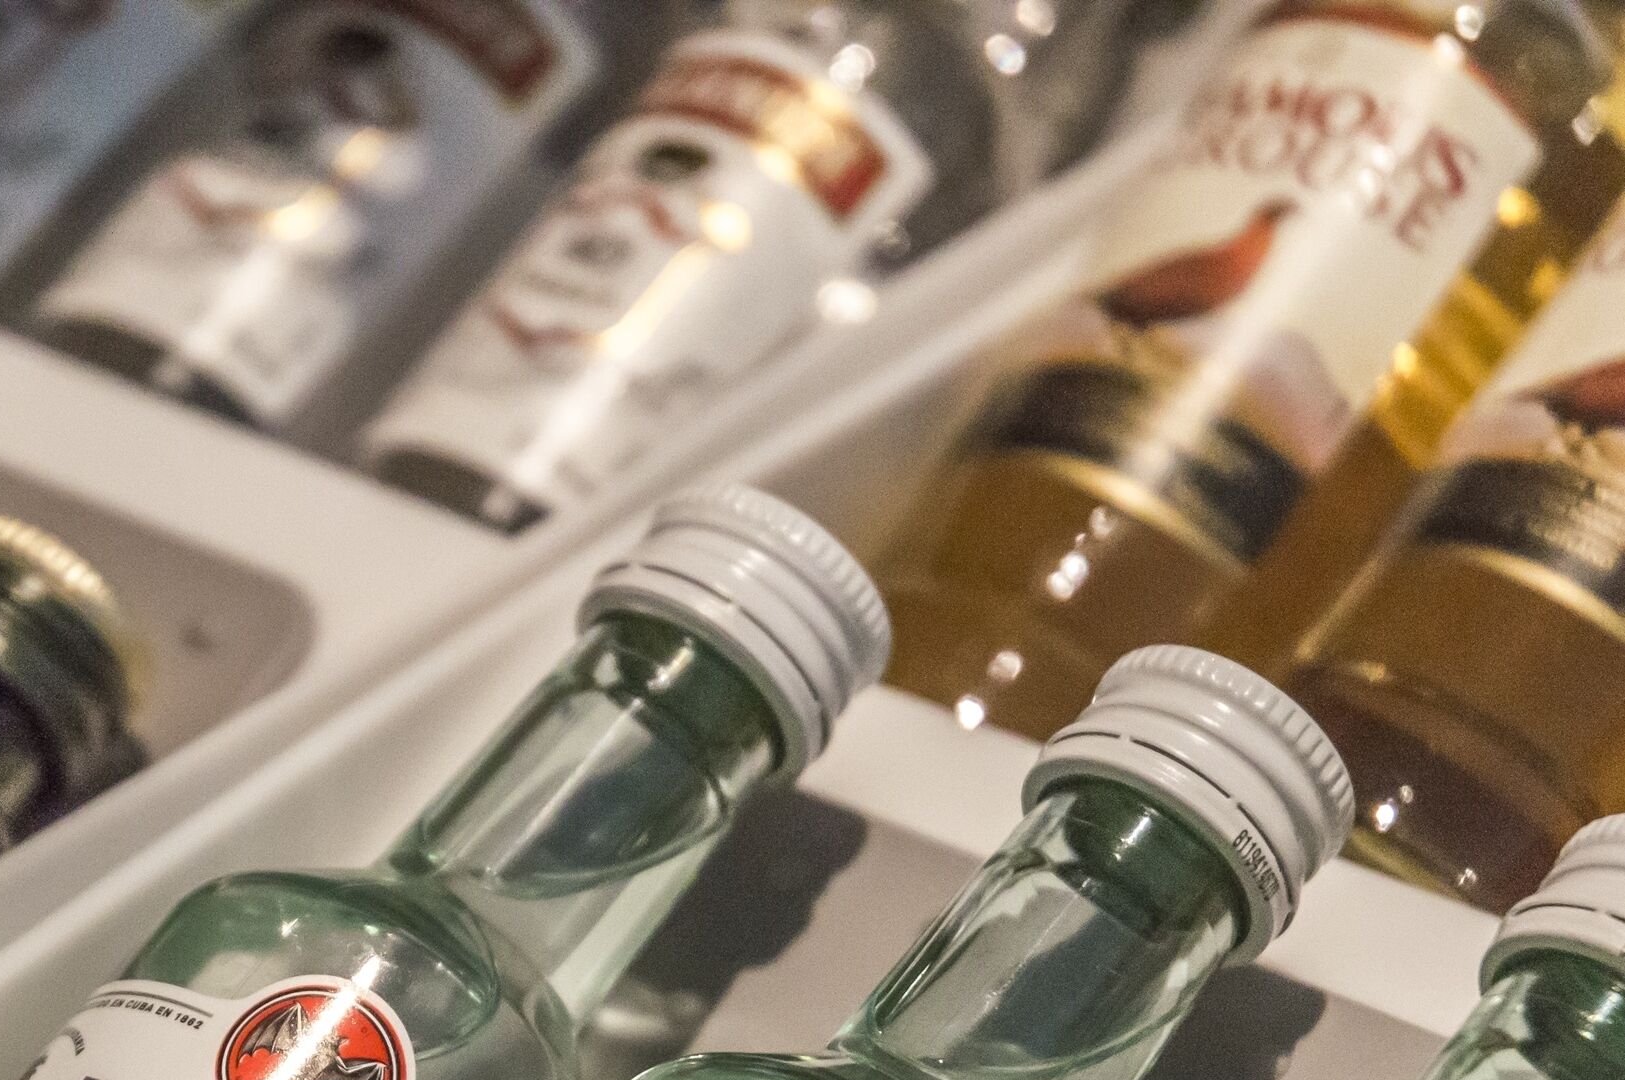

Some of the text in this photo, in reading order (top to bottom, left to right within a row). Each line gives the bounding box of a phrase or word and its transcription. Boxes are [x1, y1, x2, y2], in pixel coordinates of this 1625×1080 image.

[125, 998, 153, 1013] CUBA
[156, 1006, 173, 1018] EN
[174, 1012, 204, 1030] 1862
